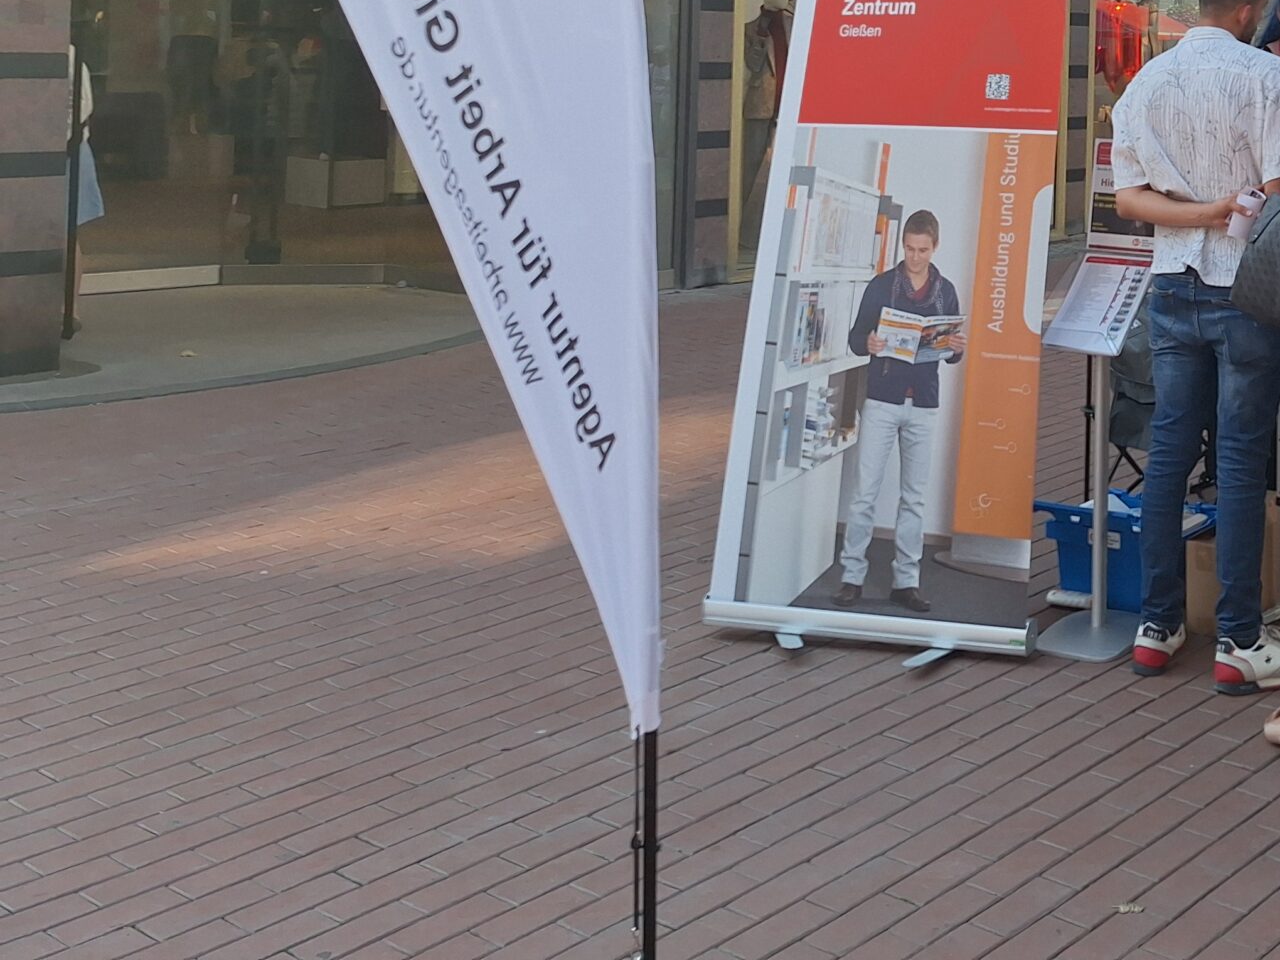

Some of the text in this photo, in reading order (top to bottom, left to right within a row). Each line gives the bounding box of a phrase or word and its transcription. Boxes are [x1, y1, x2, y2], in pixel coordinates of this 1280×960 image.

[839, 24, 882, 37] Gießen
[999, 191, 1015, 227] und
[987, 231, 1015, 334] Ausbildung
